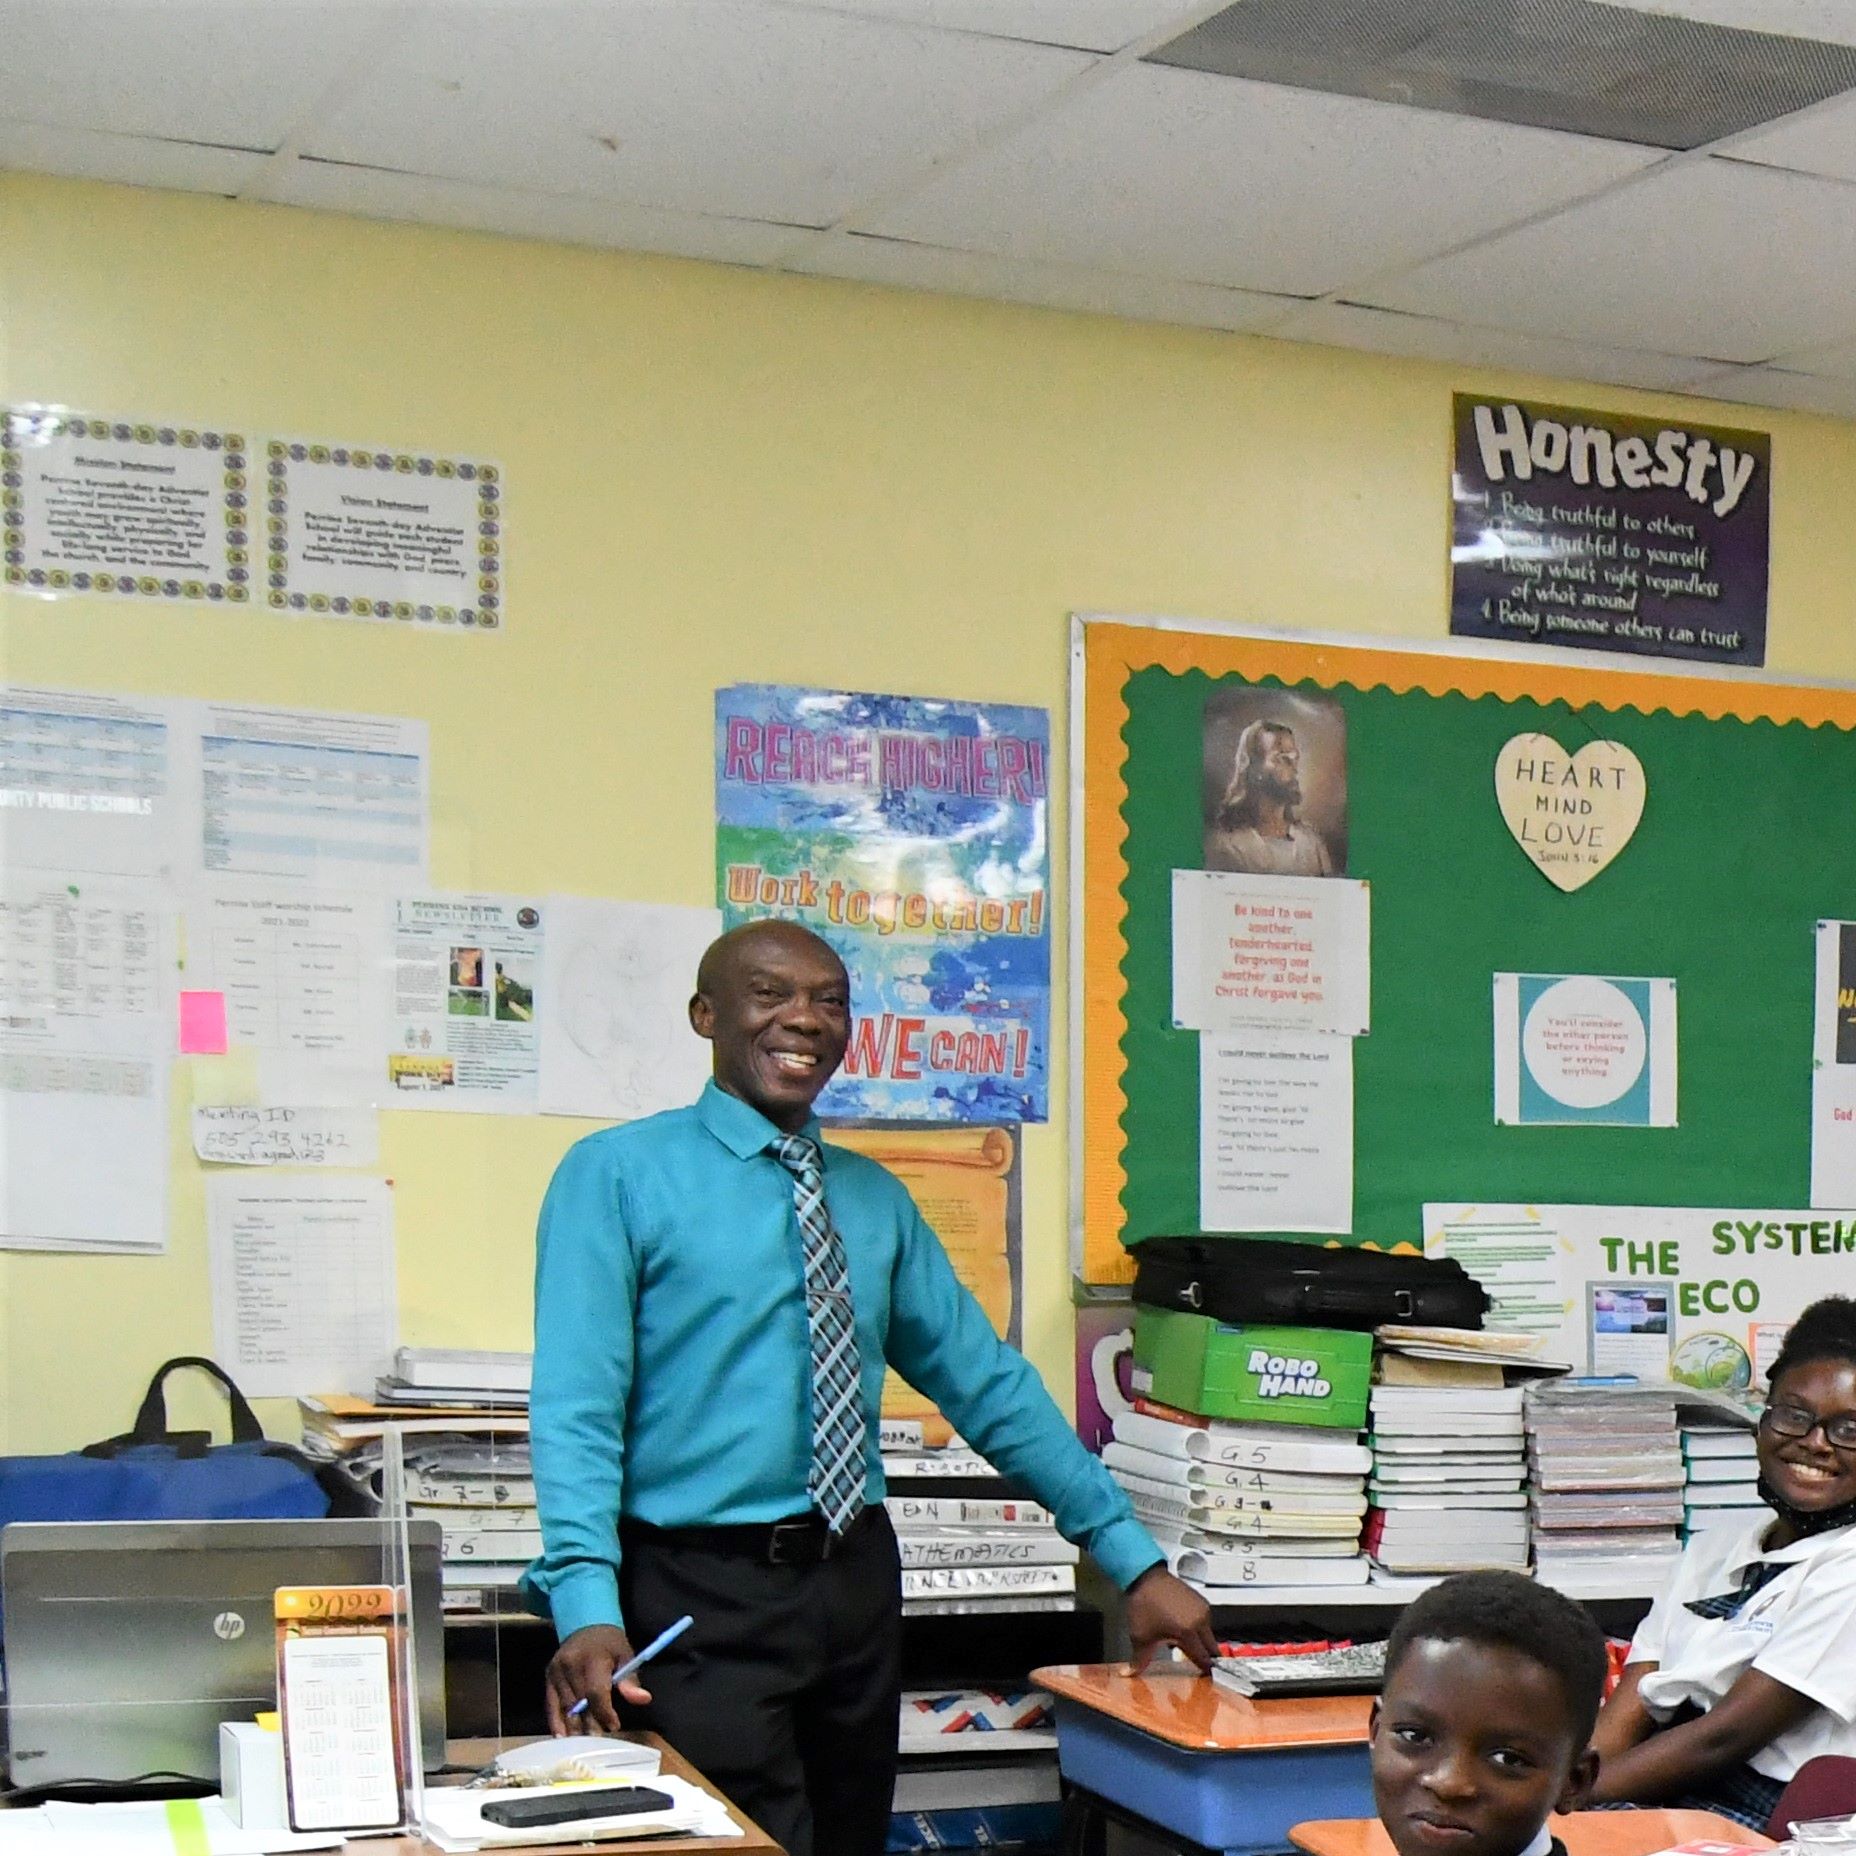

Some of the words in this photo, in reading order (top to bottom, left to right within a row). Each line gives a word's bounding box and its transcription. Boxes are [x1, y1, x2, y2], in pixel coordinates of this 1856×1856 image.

[1474, 404, 1754, 518] Honesty
[341, 495, 373, 507] Vision
[376, 498, 429, 513] Statement
[1552, 505, 1616, 529] truthful
[1624, 511, 1641, 530] to
[1647, 515, 1694, 539] others
[725, 716, 873, 785] REACH
[878, 732, 1047, 806] HIGHER!
[1516, 759, 1626, 790] HEART
[1536, 795, 1592, 815] MIND
[1521, 818, 1604, 847] LOVE
[728, 865, 818, 907] Work
[827, 879, 1044, 935] together!
[844, 1014, 925, 1079] WE
[931, 1023, 1028, 1078] CAN!
[263, 1108, 295, 1122] ID
[1834, 1108, 1852, 1121] God
[1599, 1236, 1681, 1276] THE
[1680, 1279, 1761, 1317] ECO
[1247, 1350, 1319, 1378] ROBO
[1257, 1374, 1332, 1399] HAND
[220, 1614, 240, 1632] hp
